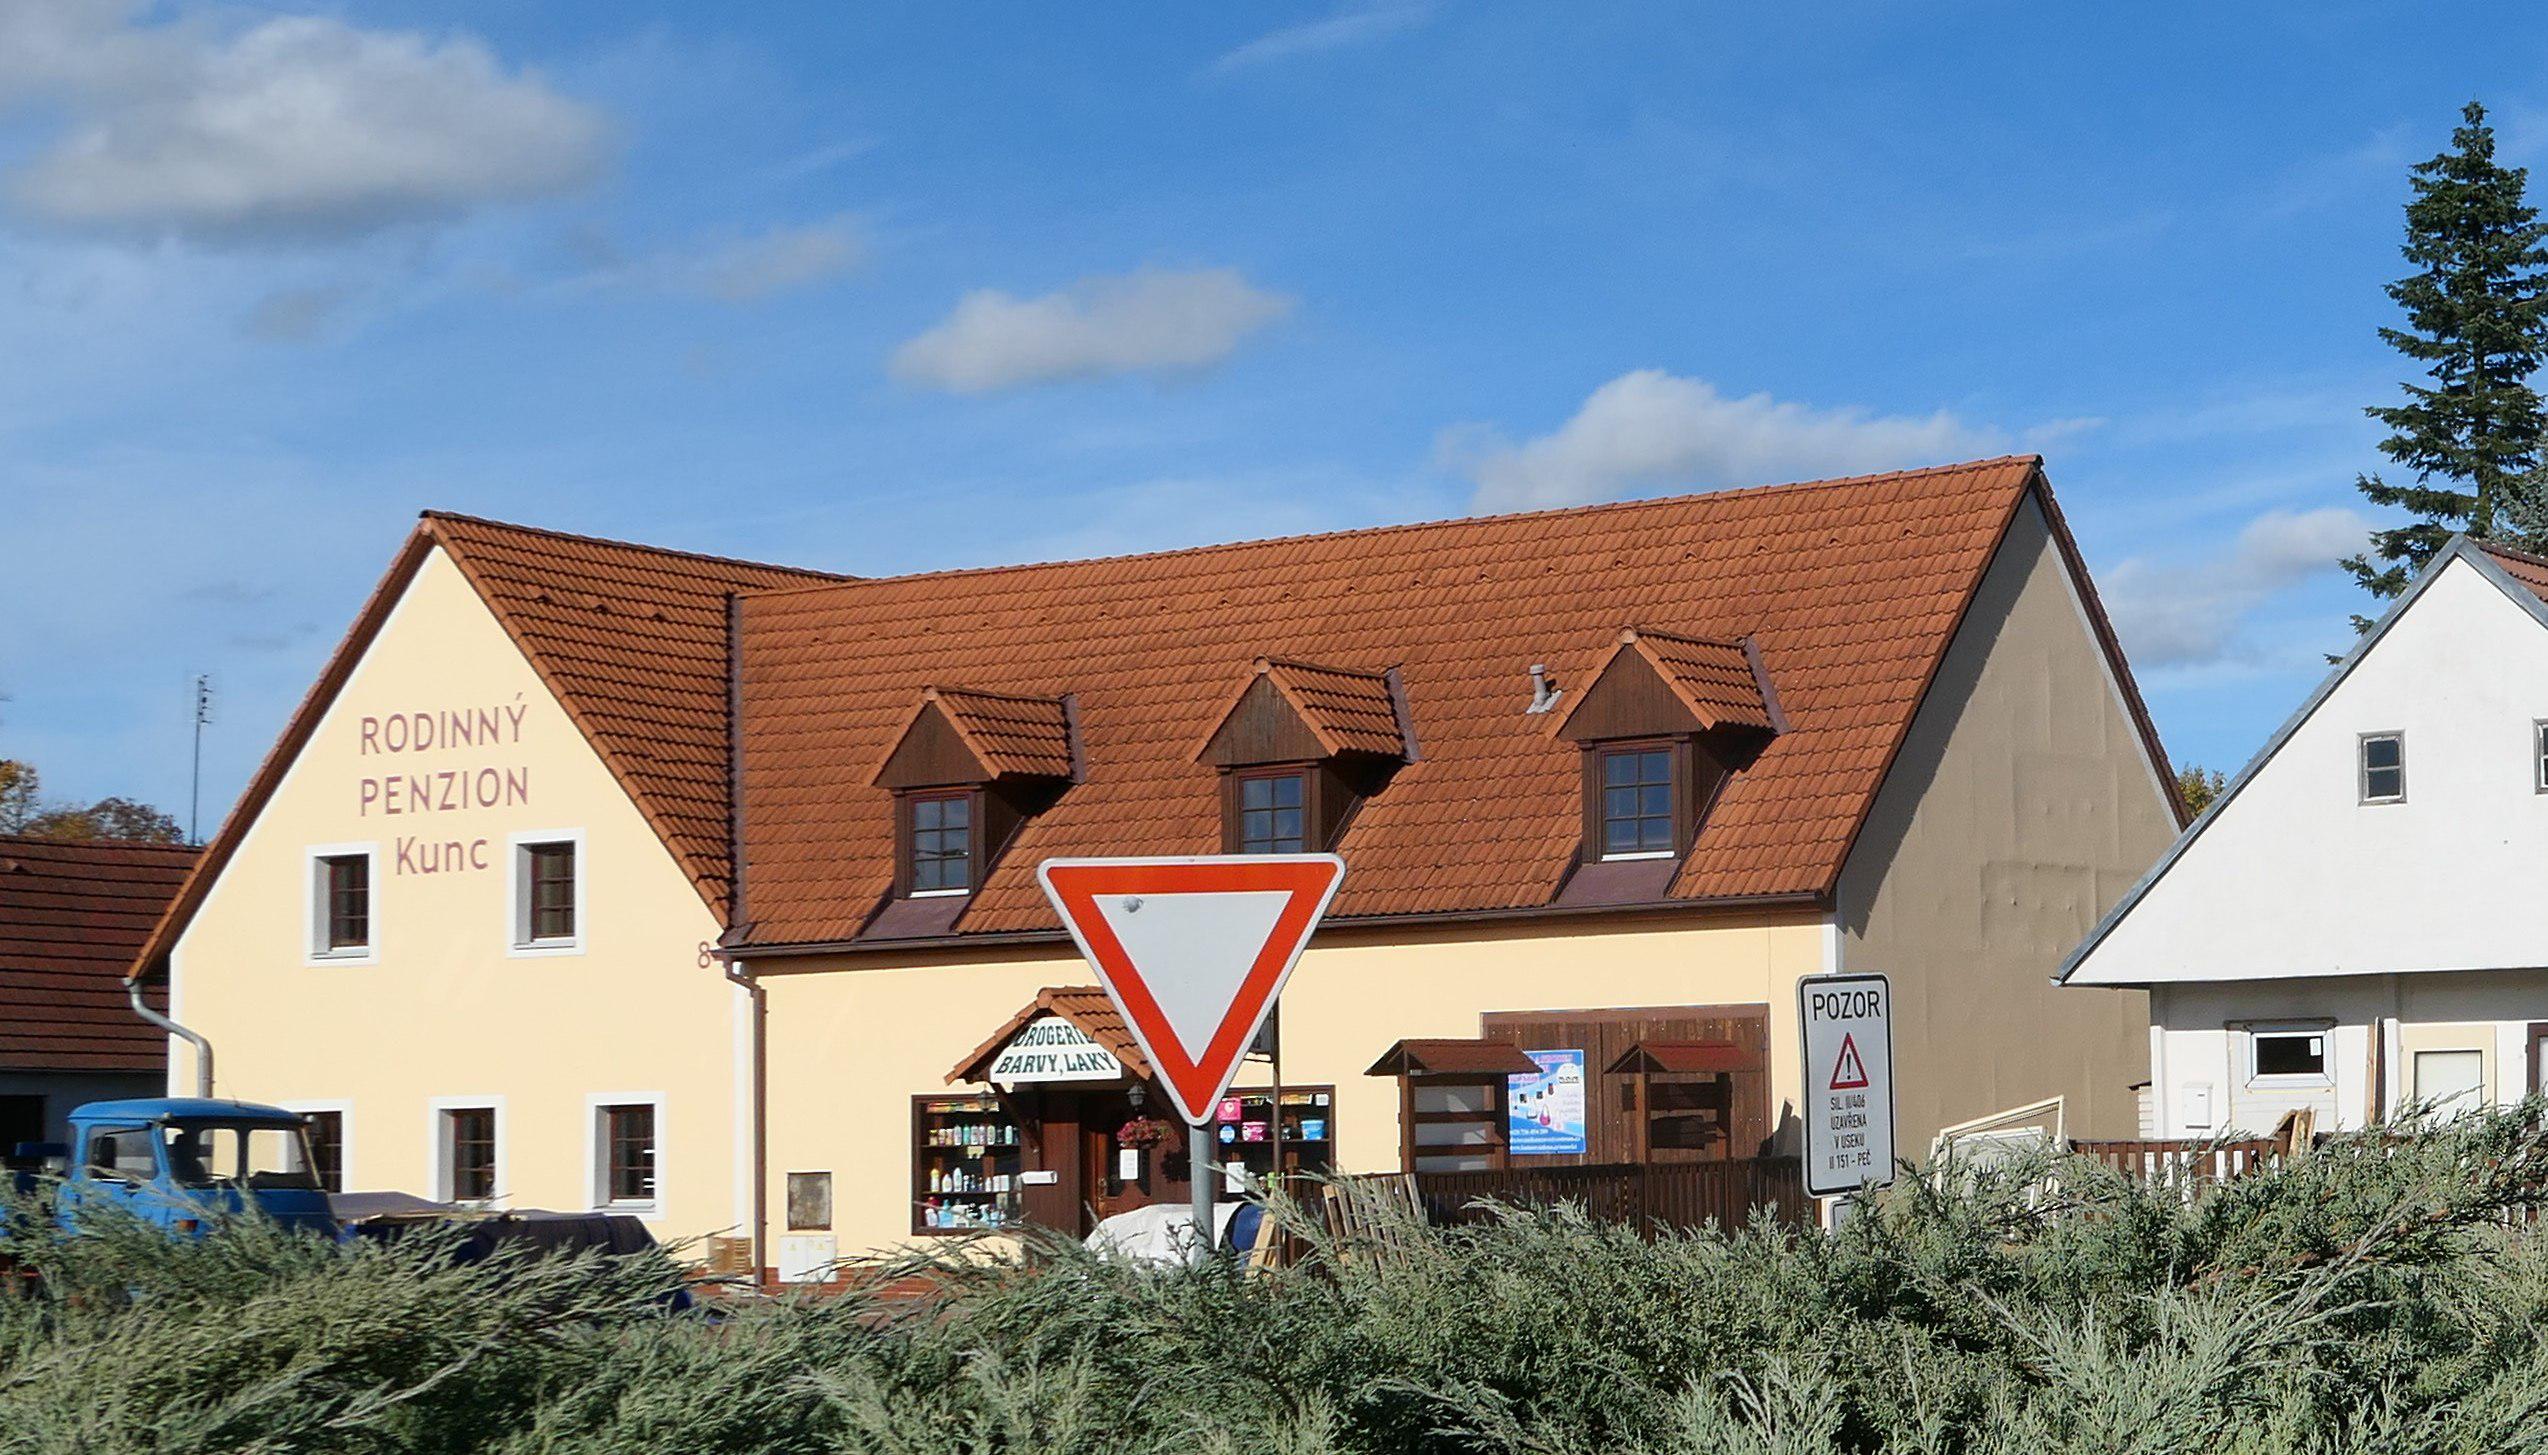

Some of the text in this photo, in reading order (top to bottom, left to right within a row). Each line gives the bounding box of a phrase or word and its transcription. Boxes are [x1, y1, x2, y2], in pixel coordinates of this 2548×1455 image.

[361, 692, 527, 755] RODINNÝ
[360, 767, 528, 816] PENZION
[396, 836, 488, 875] Kunc
[1812, 990, 1882, 1021] POZOR
[1064, 1052, 1116, 1073] LAKY
[1830, 1112, 1867, 1130] UZAVŘENA
[1834, 1135, 1840, 1149] V
[1836, 1153, 1849, 1169] 151
[1857, 1148, 1871, 1166] PEČ
